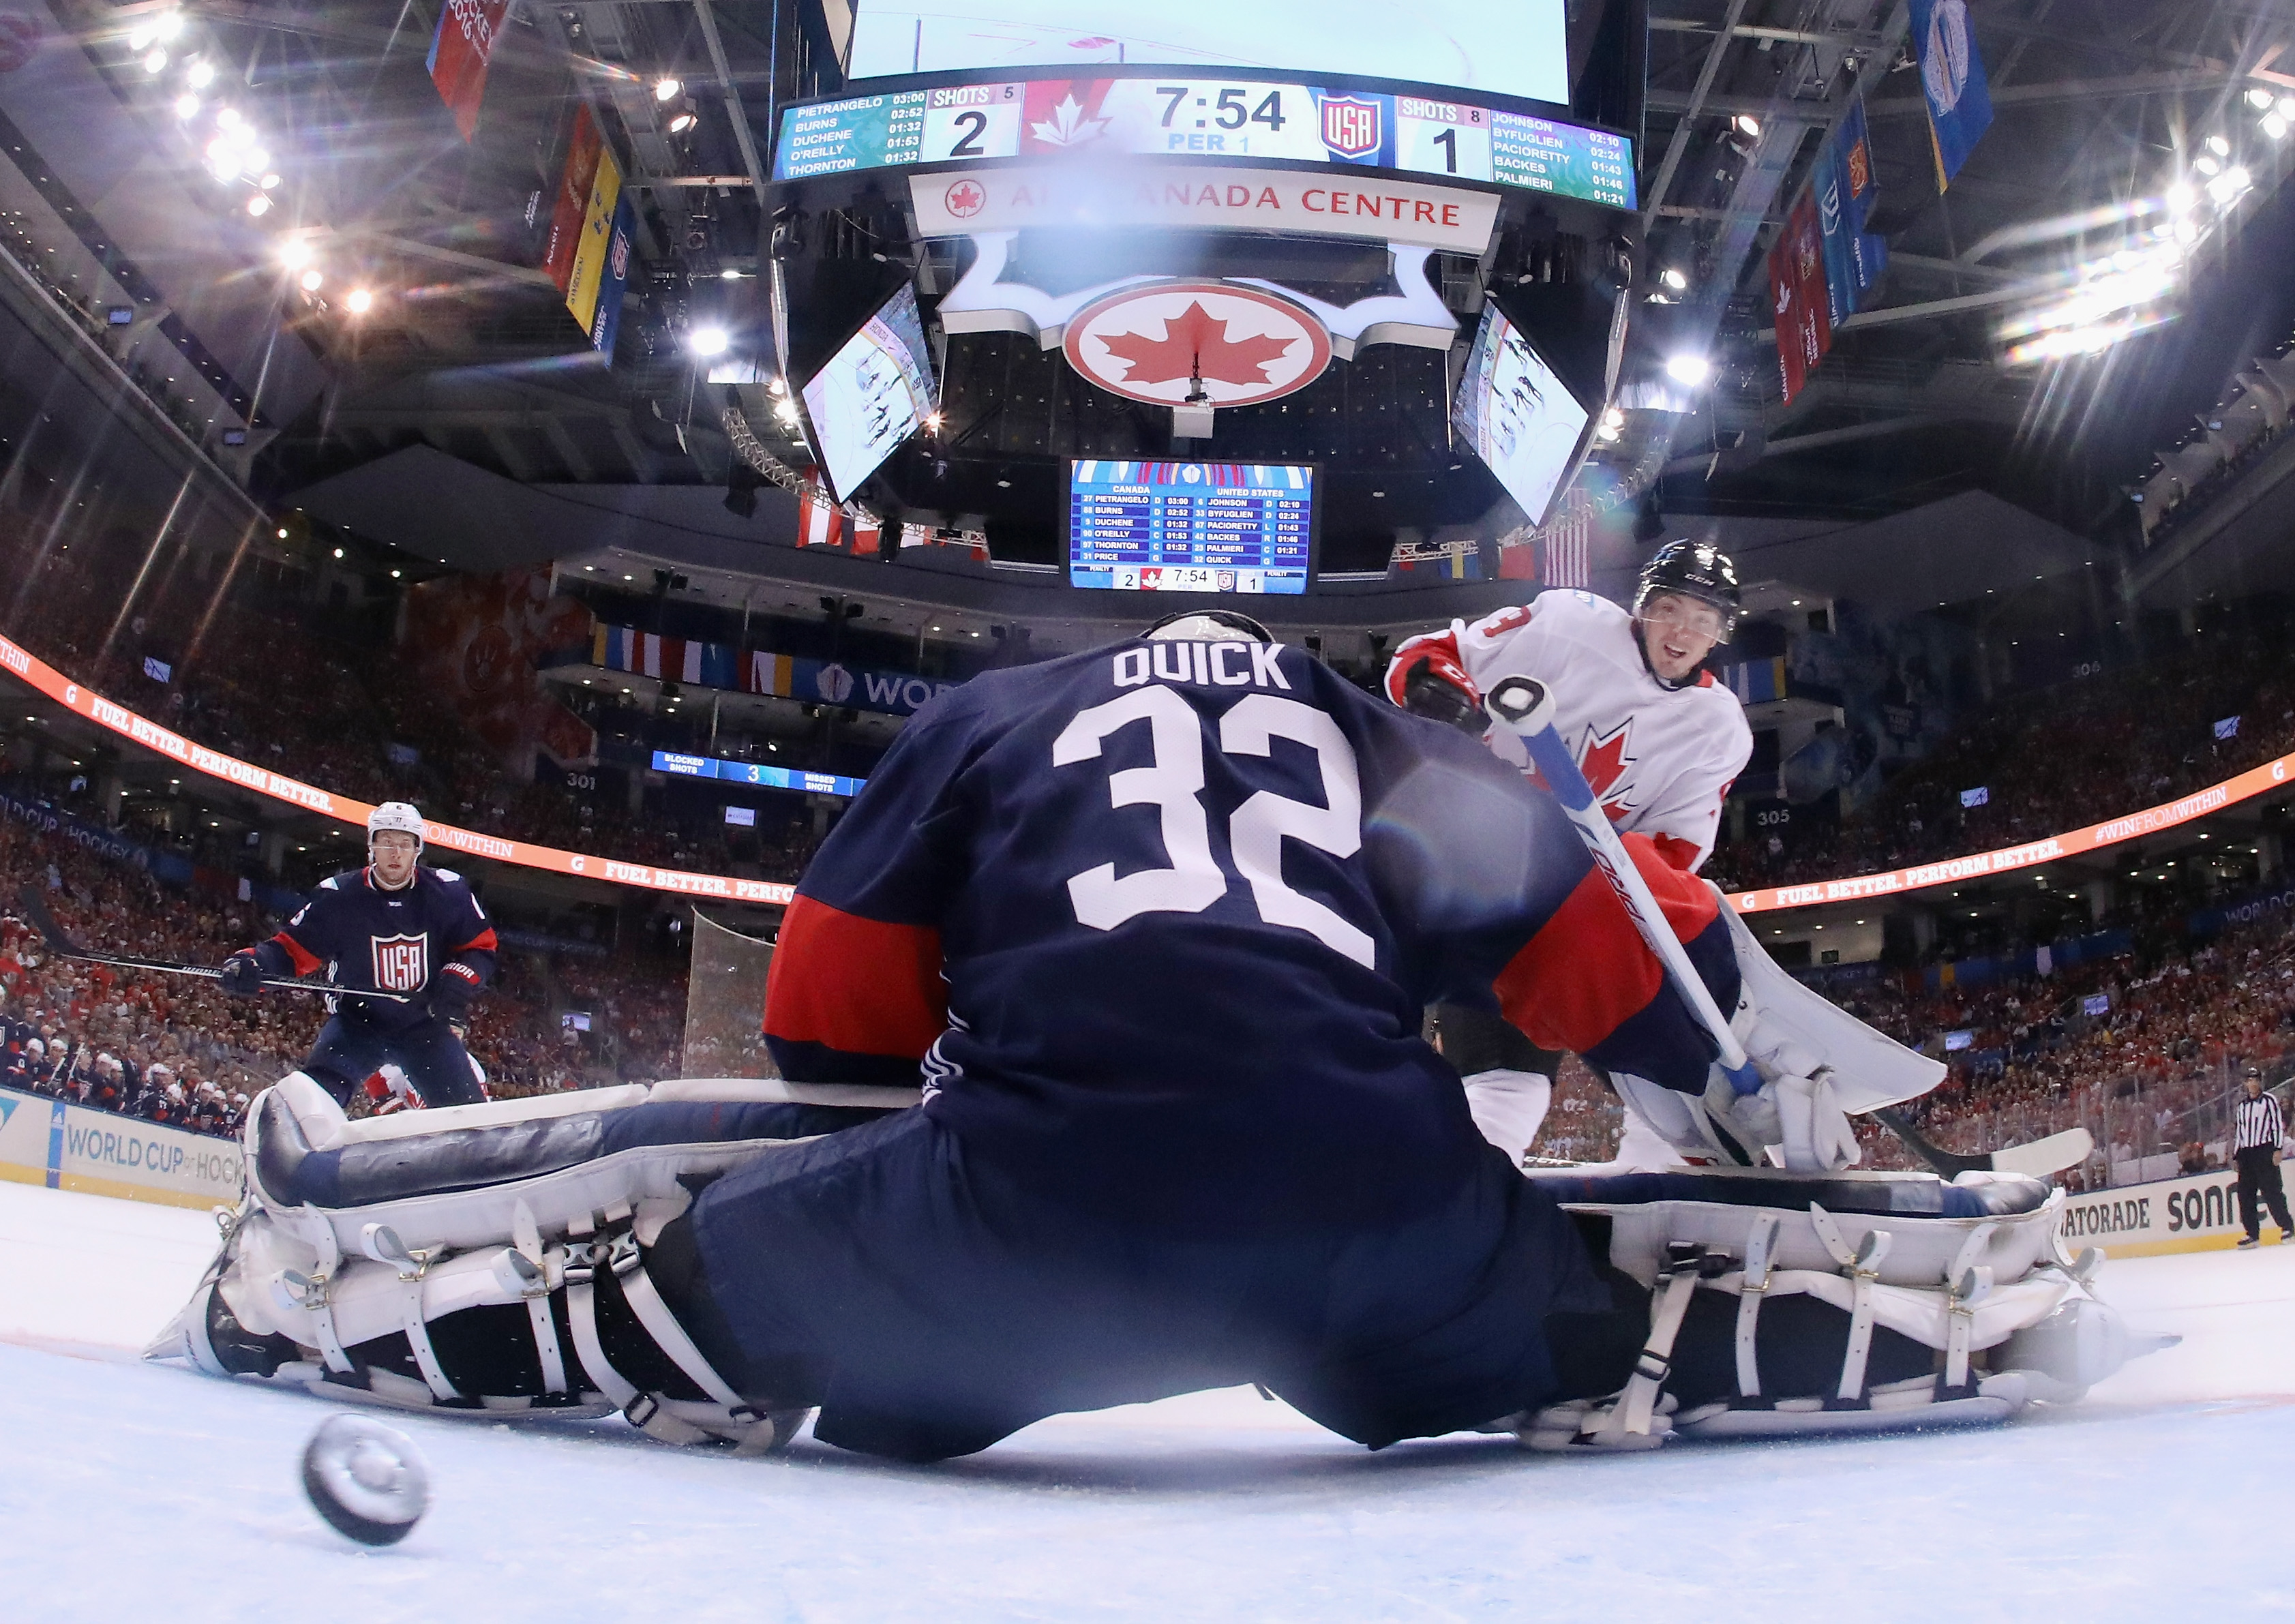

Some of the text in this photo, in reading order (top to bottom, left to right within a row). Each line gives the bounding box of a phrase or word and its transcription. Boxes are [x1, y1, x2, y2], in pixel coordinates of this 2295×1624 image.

[798, 93, 925, 119] PIETRANGELO 03:00
[934, 87, 1014, 106] SHOTS 5
[795, 107, 923, 133] BURNS 02:52
[1156, 87, 1286, 132] 7:54
[1402, 98, 1481, 123] SHOTS 8
[793, 121, 921, 147] DUCHENE 01:32
[950, 111, 987, 157] 2
[1328, 103, 1371, 151] USA
[1492, 112, 1619, 147] JOHNSON 02:10
[790, 136, 920, 161] O'REILLY 01:53
[1168, 133, 1249, 153] PER 1
[1433, 128, 1457, 174] 1
[1493, 127, 1620, 162] BYFUGLIEN 02:24
[789, 151, 918, 177] THORNTON 01:32
[1494, 141, 1622, 175] PACIORETTY 01:43
[1495, 156, 1546, 174] BACKES
[1495, 170, 1623, 205] PALMIERI 01:21
[1302, 190, 1460, 227] CENTRE
[1780, 354, 1789, 402] CANADA
[1095, 495, 1150, 505] PIETRANGELO
[1167, 497, 1189, 505] 03:00
[1113, 485, 1151, 494] CANADA
[1217, 488, 1285, 498] UNITED STATES
[1095, 507, 1124, 515] BURNS
[1154, 508, 1161, 516] D
[1167, 509, 1188, 517] 02:52
[1195, 509, 1205, 517] 33
[1208, 510, 1254, 519] BYFUGLIEN
[1265, 511, 1272, 520] D
[1208, 498, 1248, 507] JOHNSON
[1278, 500, 1300, 509] 02:10
[1094, 518, 1134, 527] DUCHENE
[1167, 520, 1188, 528] 01:32
[1094, 530, 1130, 538] O'REILLY
[1166, 532, 1188, 540] 01:53
[1195, 521, 1299, 532] 67 PACIORETTY L 01:43
[1094, 541, 1139, 550] THORNTON
[1195, 532, 1205, 541] 42
[1206, 533, 1241, 541] BACKES
[1264, 535, 1271, 543] R
[1206, 544, 1244, 553] PALMIERI
[1094, 553, 1119, 561] PRICE
[1152, 554, 1160, 562] G
[1194, 556, 1204, 564] 32
[1206, 556, 1233, 565] QUICK
[1124, 574, 1134, 586] 2
[1175, 569, 1208, 582] 7:54
[1250, 578, 1257, 590] 1
[1684, 573, 1716, 587] CCM
[1113, 642, 1292, 691] QUICK
[65, 685, 333, 813] G FUEL BETTER. PERFORM BETTER.
[567, 772, 596, 791] 301
[664, 753, 837, 785] BLOCKED 3 MISSED
[670, 762, 834, 793] SHOTS SHOTS
[2095, 761, 2285, 843] #WINFROMWITHIN G
[1053, 685, 1375, 971] 32
[1758, 809, 1790, 826] 305
[571, 856, 796, 902] G FUEL BETTER. PERFO
[1741, 839, 2064, 909] G FUEL BETTER. PERFORM BETTER.
[382, 944, 421, 991] USA
[68, 1124, 142, 1167] WORLD
[145, 1141, 184, 1173] CUP
[2060, 1197, 2150, 1237] ATORADE
